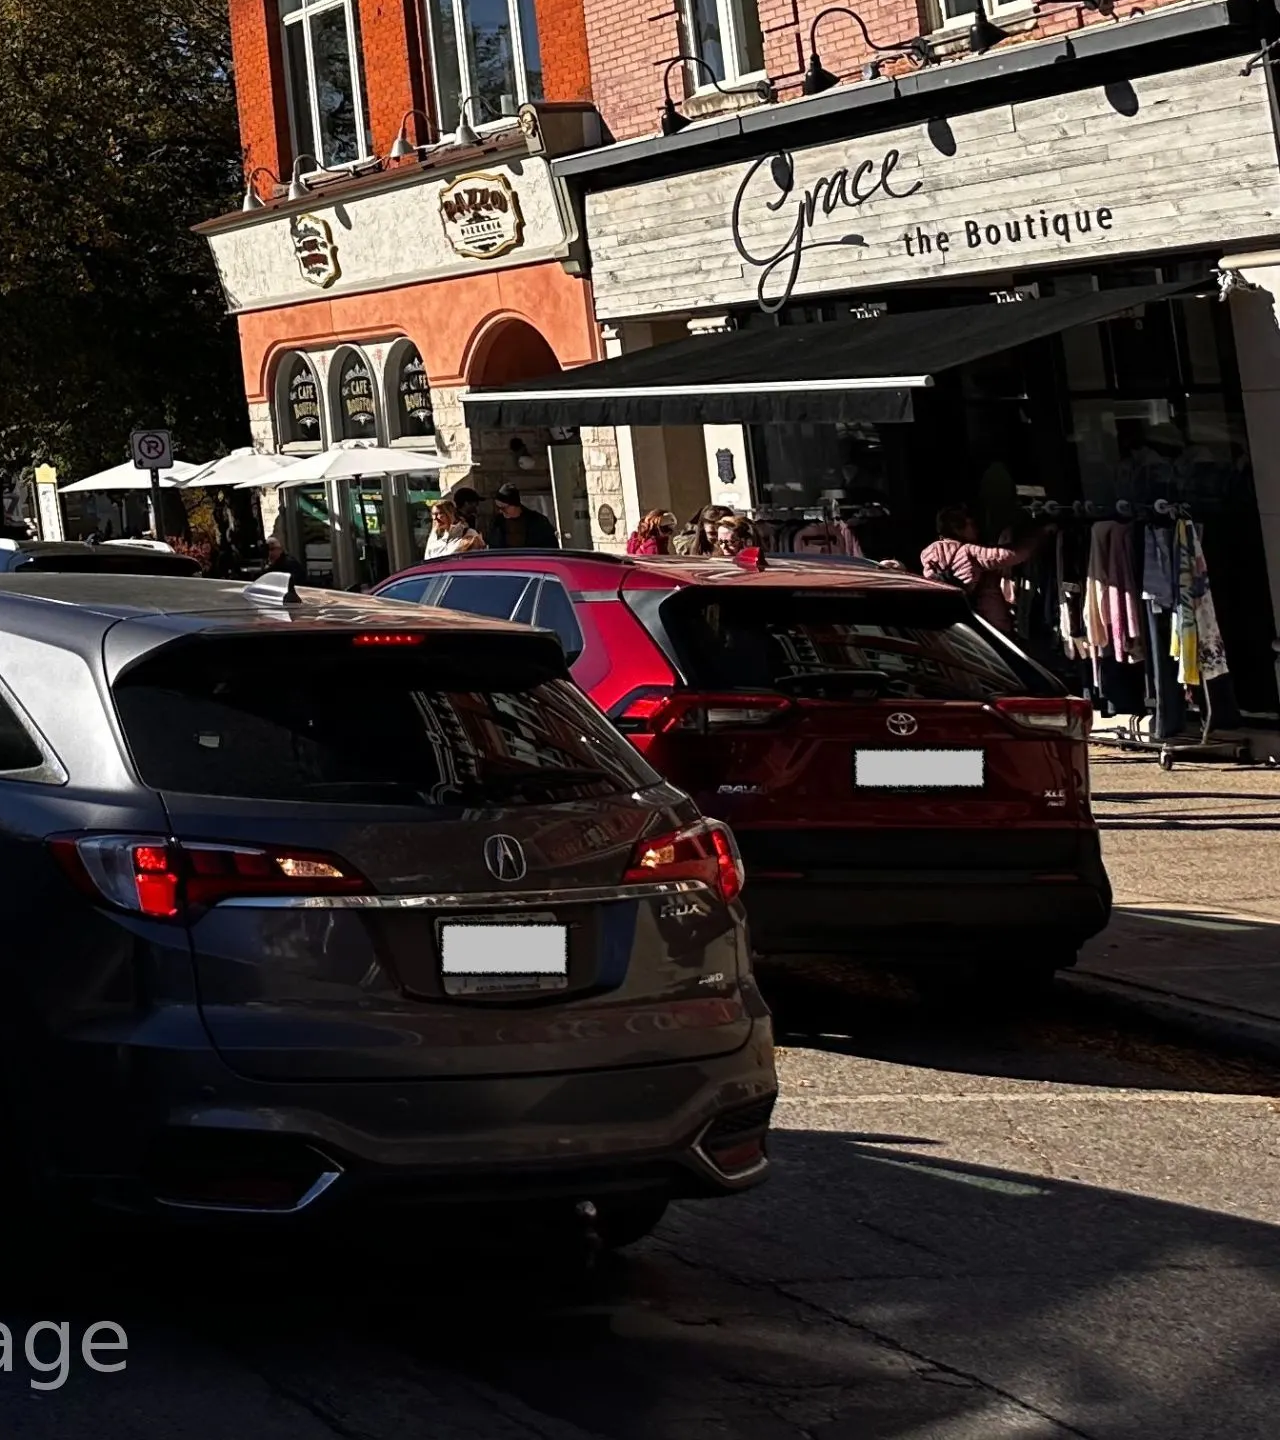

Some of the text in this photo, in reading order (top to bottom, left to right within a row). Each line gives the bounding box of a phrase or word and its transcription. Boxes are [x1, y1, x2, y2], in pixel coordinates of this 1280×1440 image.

[732, 148, 923, 313] Grace
[903, 206, 1113, 257] the Boutique
